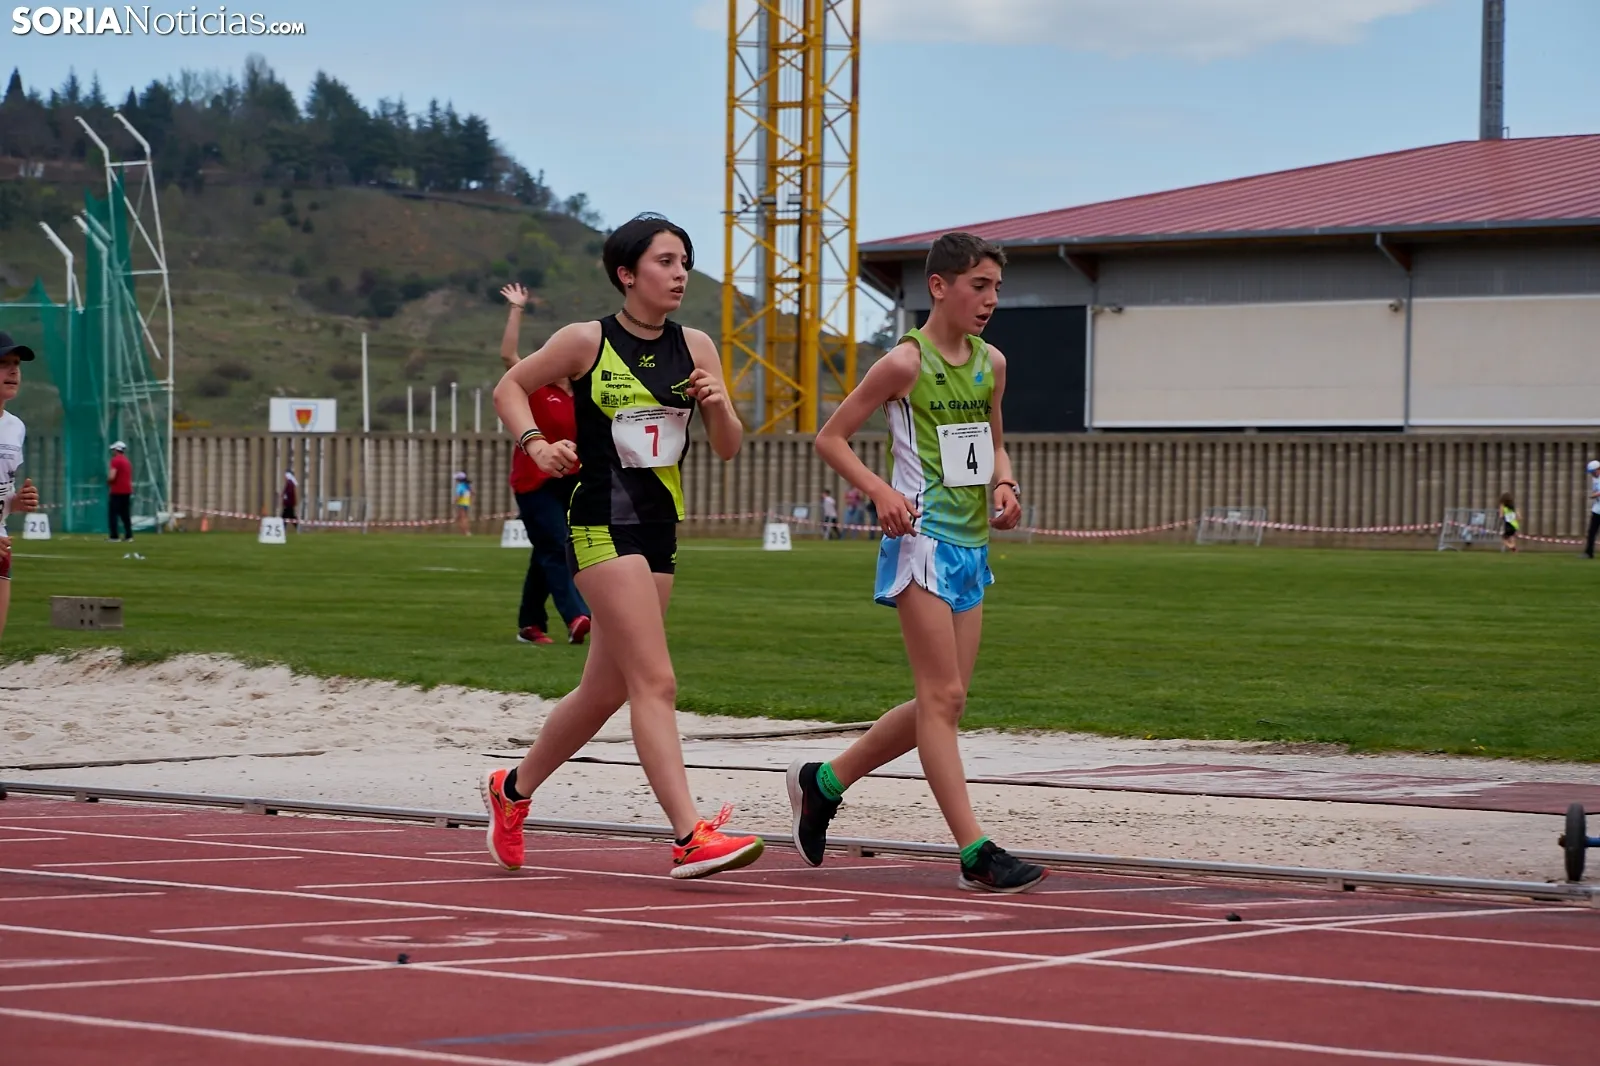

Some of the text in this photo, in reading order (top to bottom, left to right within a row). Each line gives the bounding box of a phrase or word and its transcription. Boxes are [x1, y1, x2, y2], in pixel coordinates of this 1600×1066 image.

[930, 400, 945, 410] LA
[644, 424, 659, 457] 7
[966, 442, 979, 475] 4
[30, 521, 46, 533] 20
[265, 525, 281, 537] 25
[771, 532, 788, 545] 35
